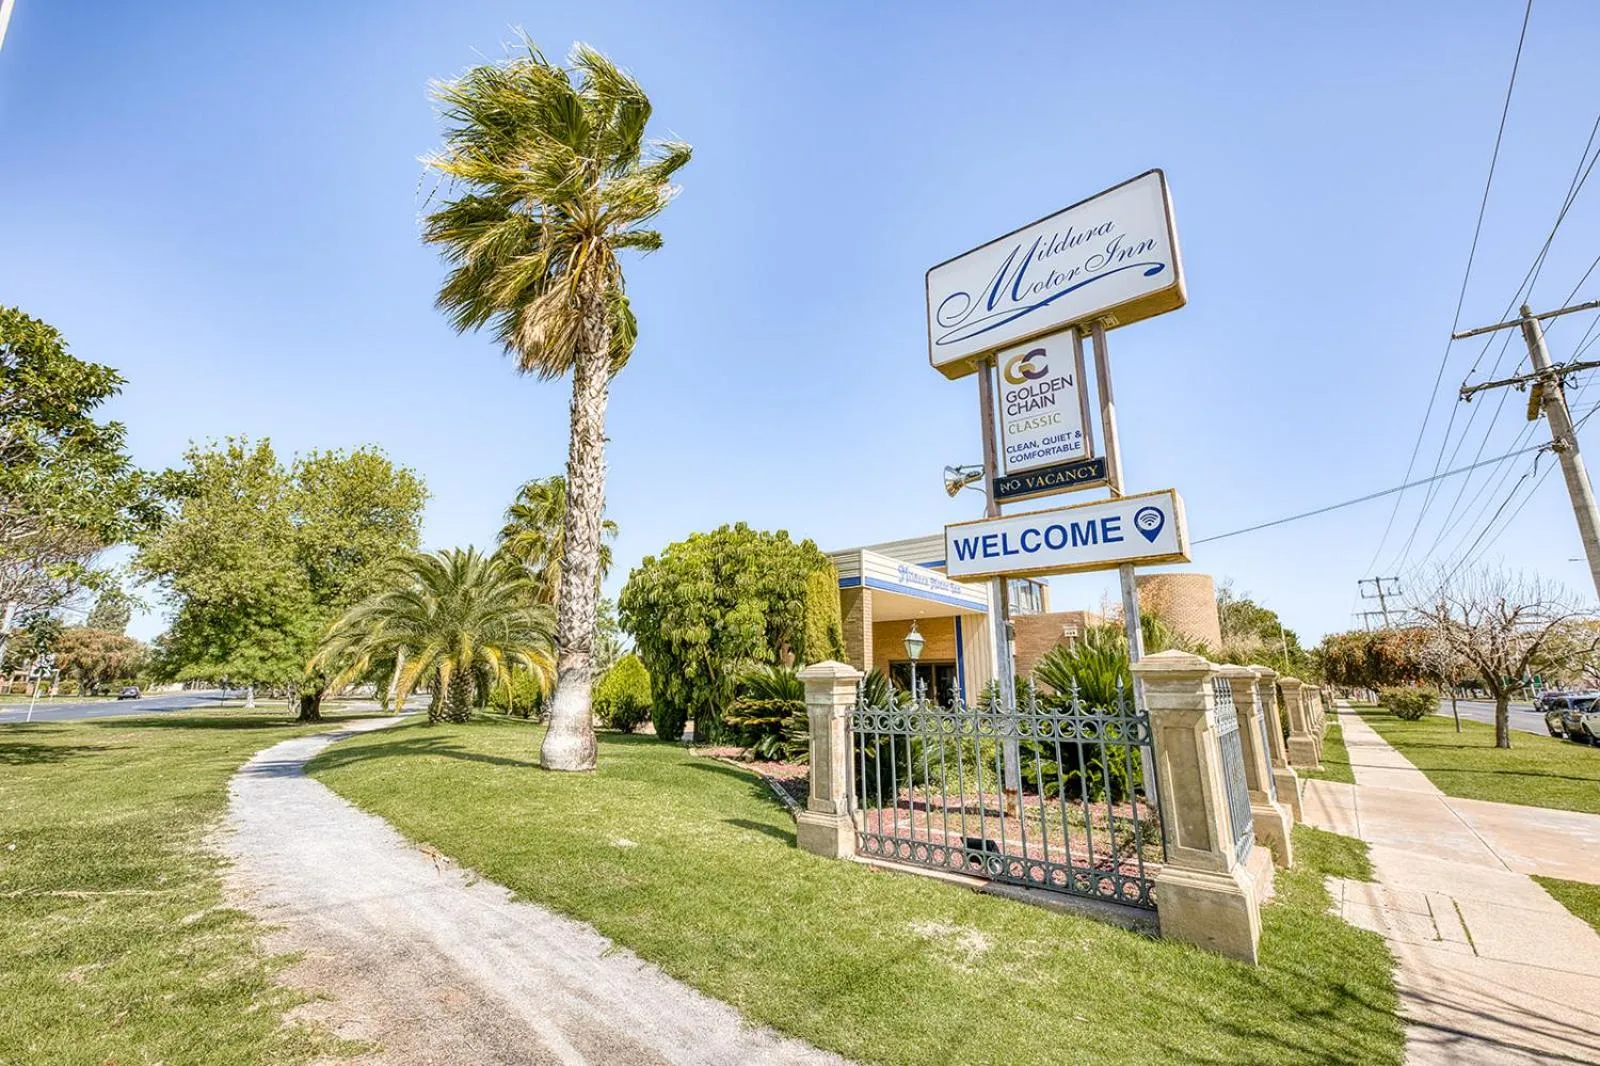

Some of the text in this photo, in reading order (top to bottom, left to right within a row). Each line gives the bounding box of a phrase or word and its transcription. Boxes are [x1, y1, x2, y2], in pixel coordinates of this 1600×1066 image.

[1085, 233, 1157, 272] Inn
[937, 220, 1115, 328] Mildura
[1006, 374, 1073, 403] GOLDEN
[1007, 393, 1055, 416] CHAIN
[1008, 412, 1062, 435] CLASSIC
[1006, 430, 1082, 454] CLEAN, QUIET &
[1009, 441, 1081, 464] COMFORTABLE
[1000, 465, 1098, 494] NO VACANCY
[953, 516, 1124, 561] WELCOME
